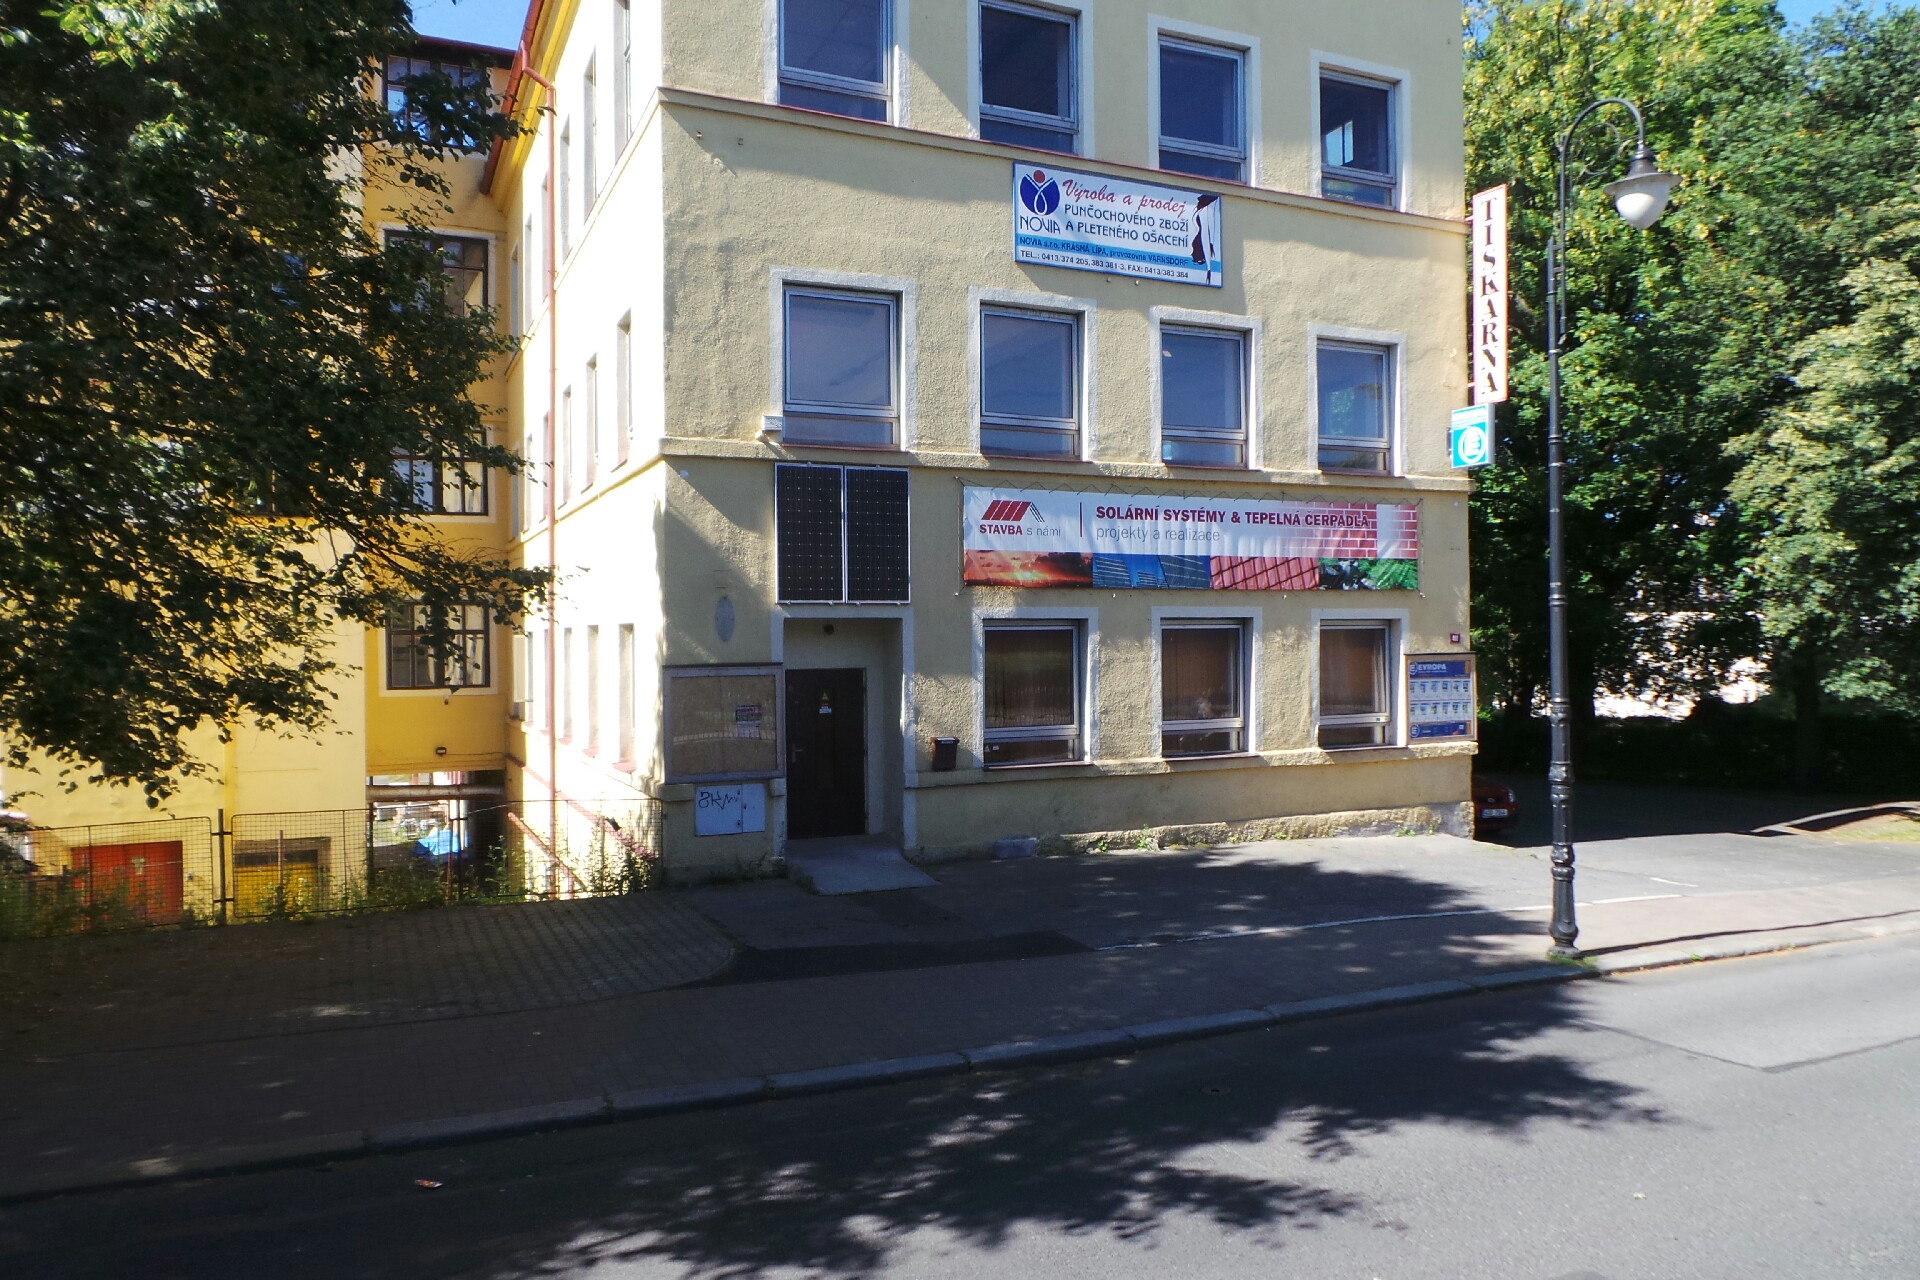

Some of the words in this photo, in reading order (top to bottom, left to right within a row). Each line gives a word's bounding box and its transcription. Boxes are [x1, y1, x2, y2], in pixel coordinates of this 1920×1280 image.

[1062, 179, 1116, 202] Výroba
[1122, 195, 1133, 205] a
[1137, 195, 1187, 218] prodej
[1020, 215, 1061, 235] NOVIA
[1064, 204, 1155, 227] PUNČOCHOVÉHO
[1159, 218, 1189, 233] ZBOŽÍ
[1065, 220, 1074, 231] A
[1077, 222, 1138, 240] PLETENÉHO
[1142, 230, 1189, 248] OŠACENÍ
[1019, 237, 1042, 247] NOVIA
[1043, 241, 1060, 249] s.r.o.
[1061, 241, 1090, 253] KRÁSNÁ
[1091, 245, 1109, 257] LÍPA,
[1109, 250, 1146, 261] provozovna
[1147, 254, 1189, 266] VARNSDORF
[1041, 252, 1074, 263] 0413/374
[1127, 264, 1143, 272] FAX:
[1144, 266, 1175, 277] 0413/383
[1096, 504, 1159, 521] SOLÁRNÍ
[1163, 507, 1226, 523] SYSTÉMY
[1230, 512, 1241, 523] &
[1244, 510, 1301, 526] TEPELNÁ
[1304, 510, 1370, 527] ČERPADLA
[979, 524, 1023, 535] STAVBA
[1026, 527, 1033, 536] s
[1036, 525, 1062, 537] námi
[1096, 526, 1148, 542] projekty
[1153, 529, 1161, 540] a
[1164, 528, 1221, 542] realizace
